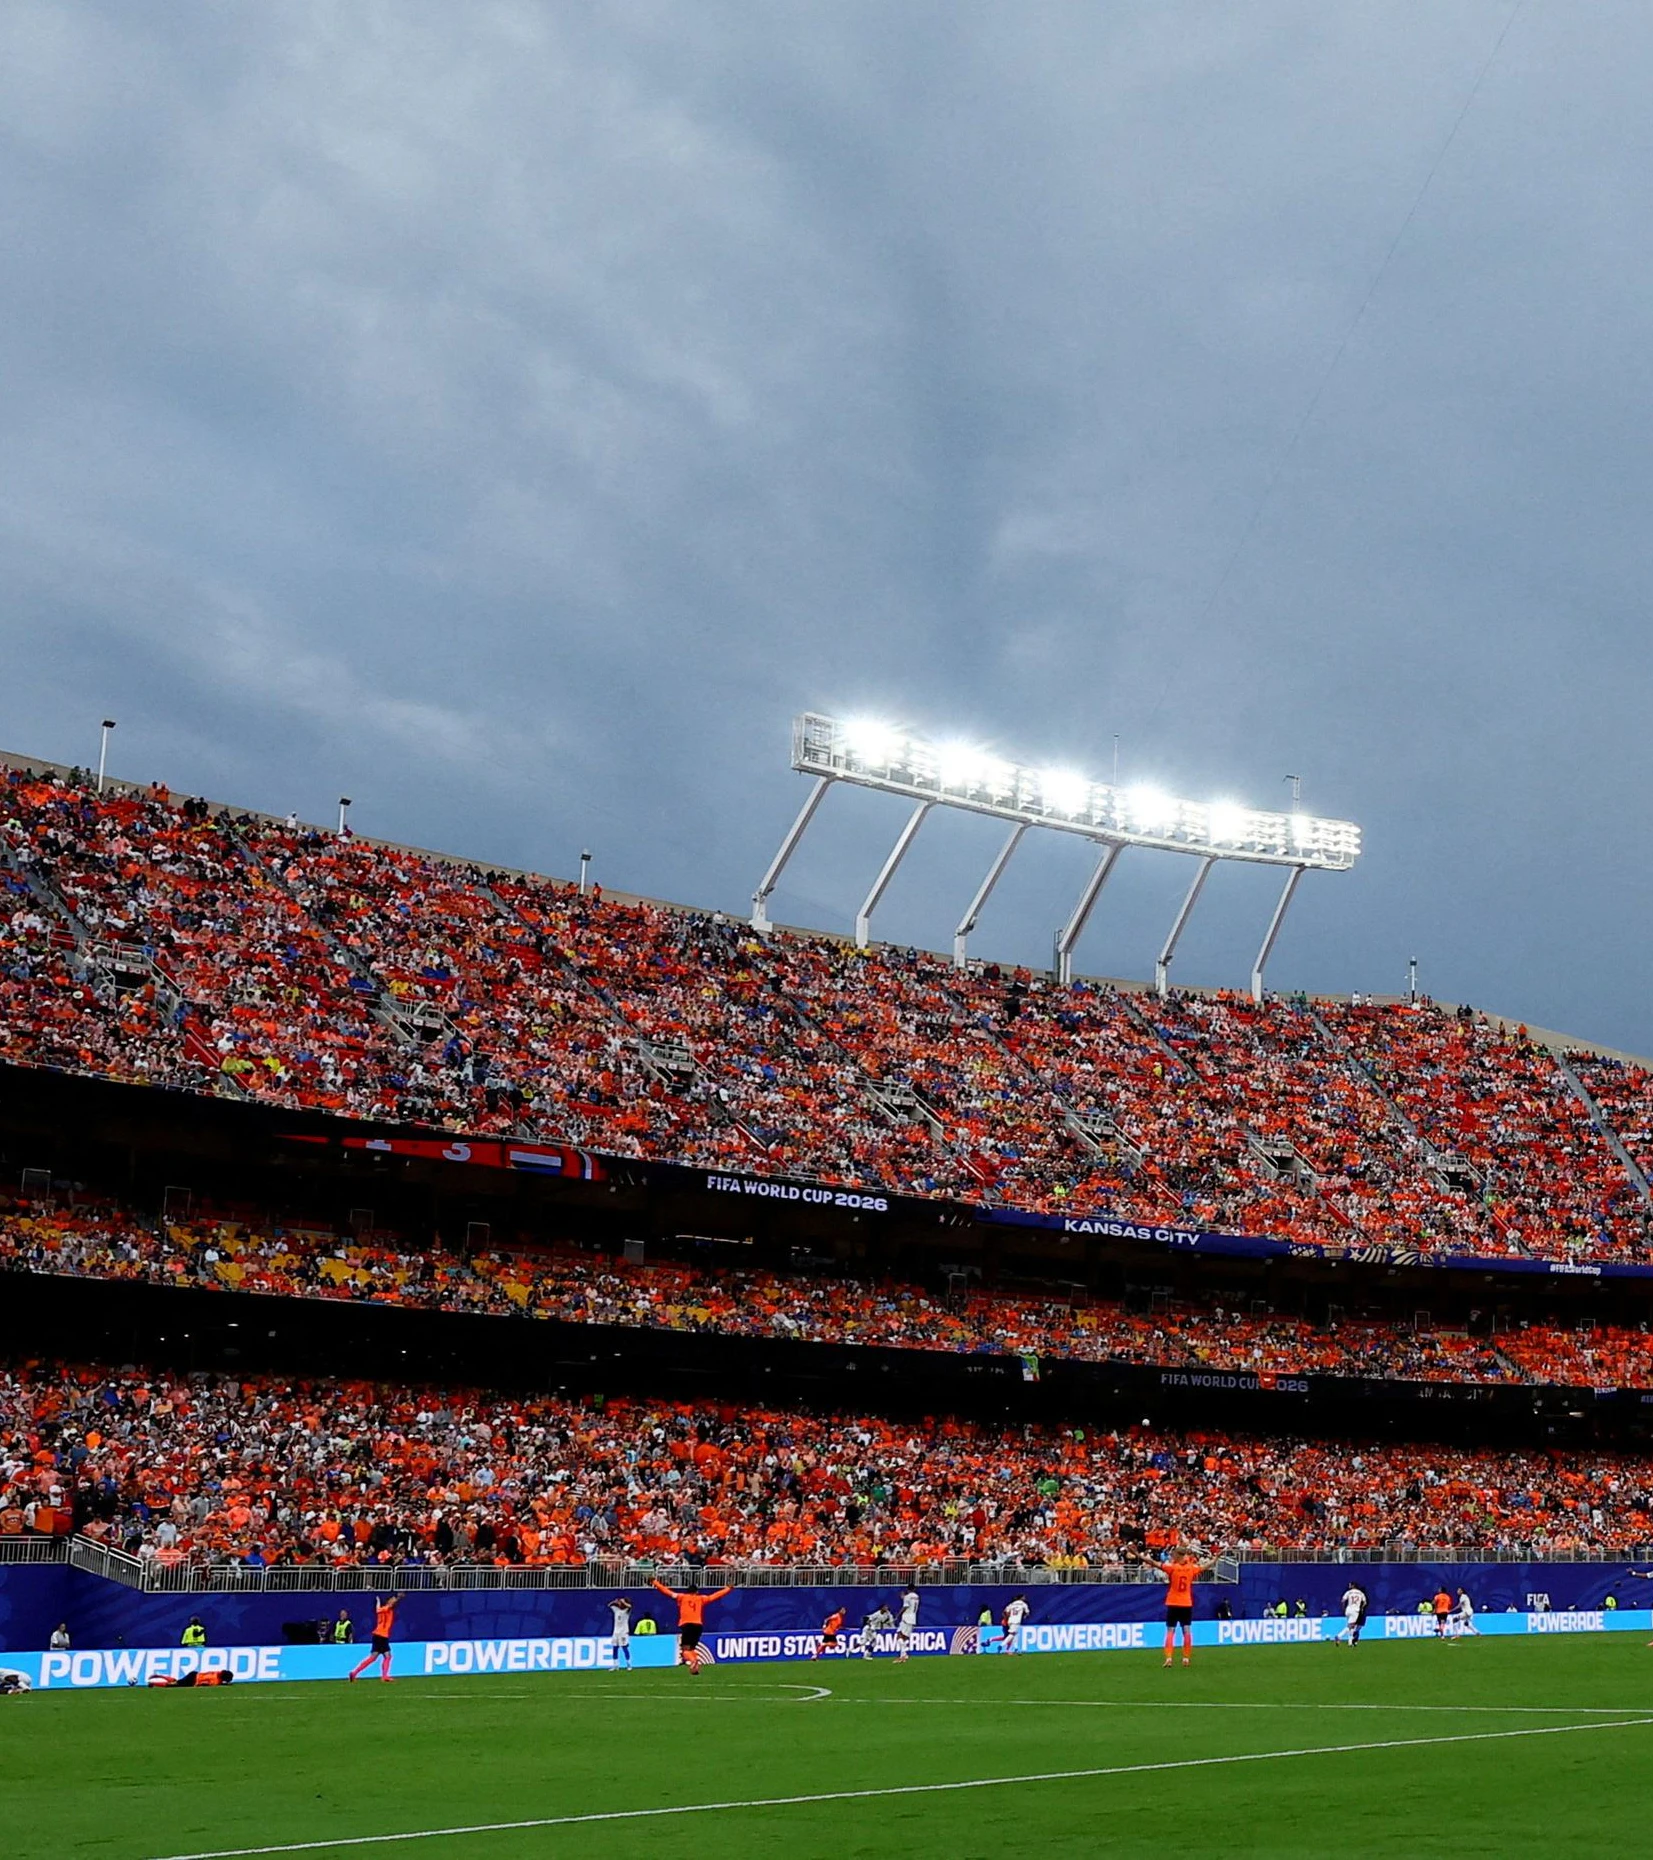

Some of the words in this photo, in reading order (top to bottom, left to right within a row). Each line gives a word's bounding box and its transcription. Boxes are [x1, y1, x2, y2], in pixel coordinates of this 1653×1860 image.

[706, 1175, 741, 1193] FIFA
[743, 1180, 800, 1200] WORLD
[802, 1188, 833, 1204] CUP
[835, 1192, 889, 1212] 2026
[1065, 1219, 1151, 1240] KANSAS
[1155, 1229, 1200, 1246] CITY
[1160, 1373, 1188, 1386] FIFA
[1190, 1375, 1237, 1389] WORLD
[1274, 1379, 1309, 1393] 026
[1178, 1576, 1188, 1593] 6
[688, 1600, 697, 1612] 4
[1351, 1595, 1360, 1605] 12
[1219, 1618, 1323, 1643] POWERADE
[1527, 1611, 1604, 1633] POWERADE
[716, 1637, 781, 1659] UNITED
[872, 1631, 946, 1654] AMRICA
[1021, 1623, 1144, 1651] POWERADE
[39, 1647, 282, 1687] POWERADE
[424, 1637, 614, 1673] POWERADE
